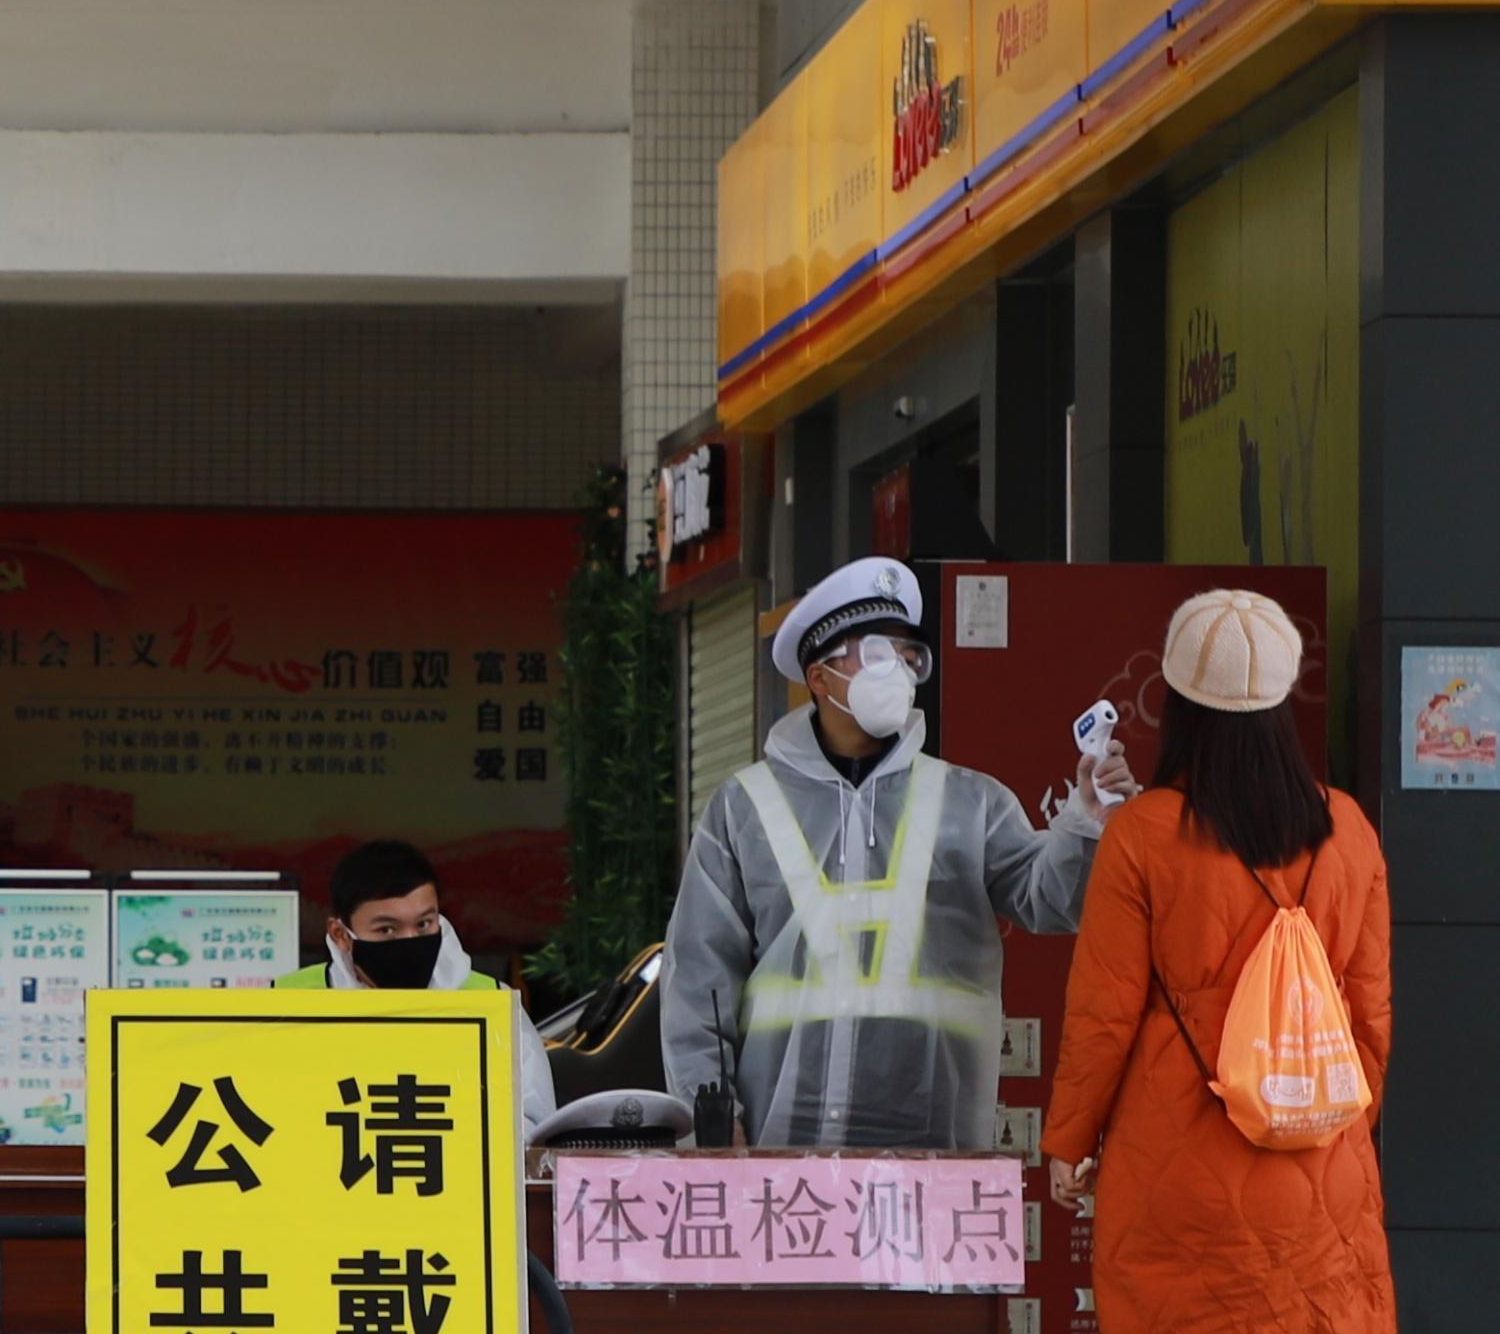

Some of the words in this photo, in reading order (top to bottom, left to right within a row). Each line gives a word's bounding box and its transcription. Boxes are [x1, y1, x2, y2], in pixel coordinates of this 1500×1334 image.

[473, 649, 549, 685] 富强
[475, 699, 547, 733] 自由
[473, 746, 549, 782] 爱国
[564, 1176, 1021, 1265] 体温检测点
